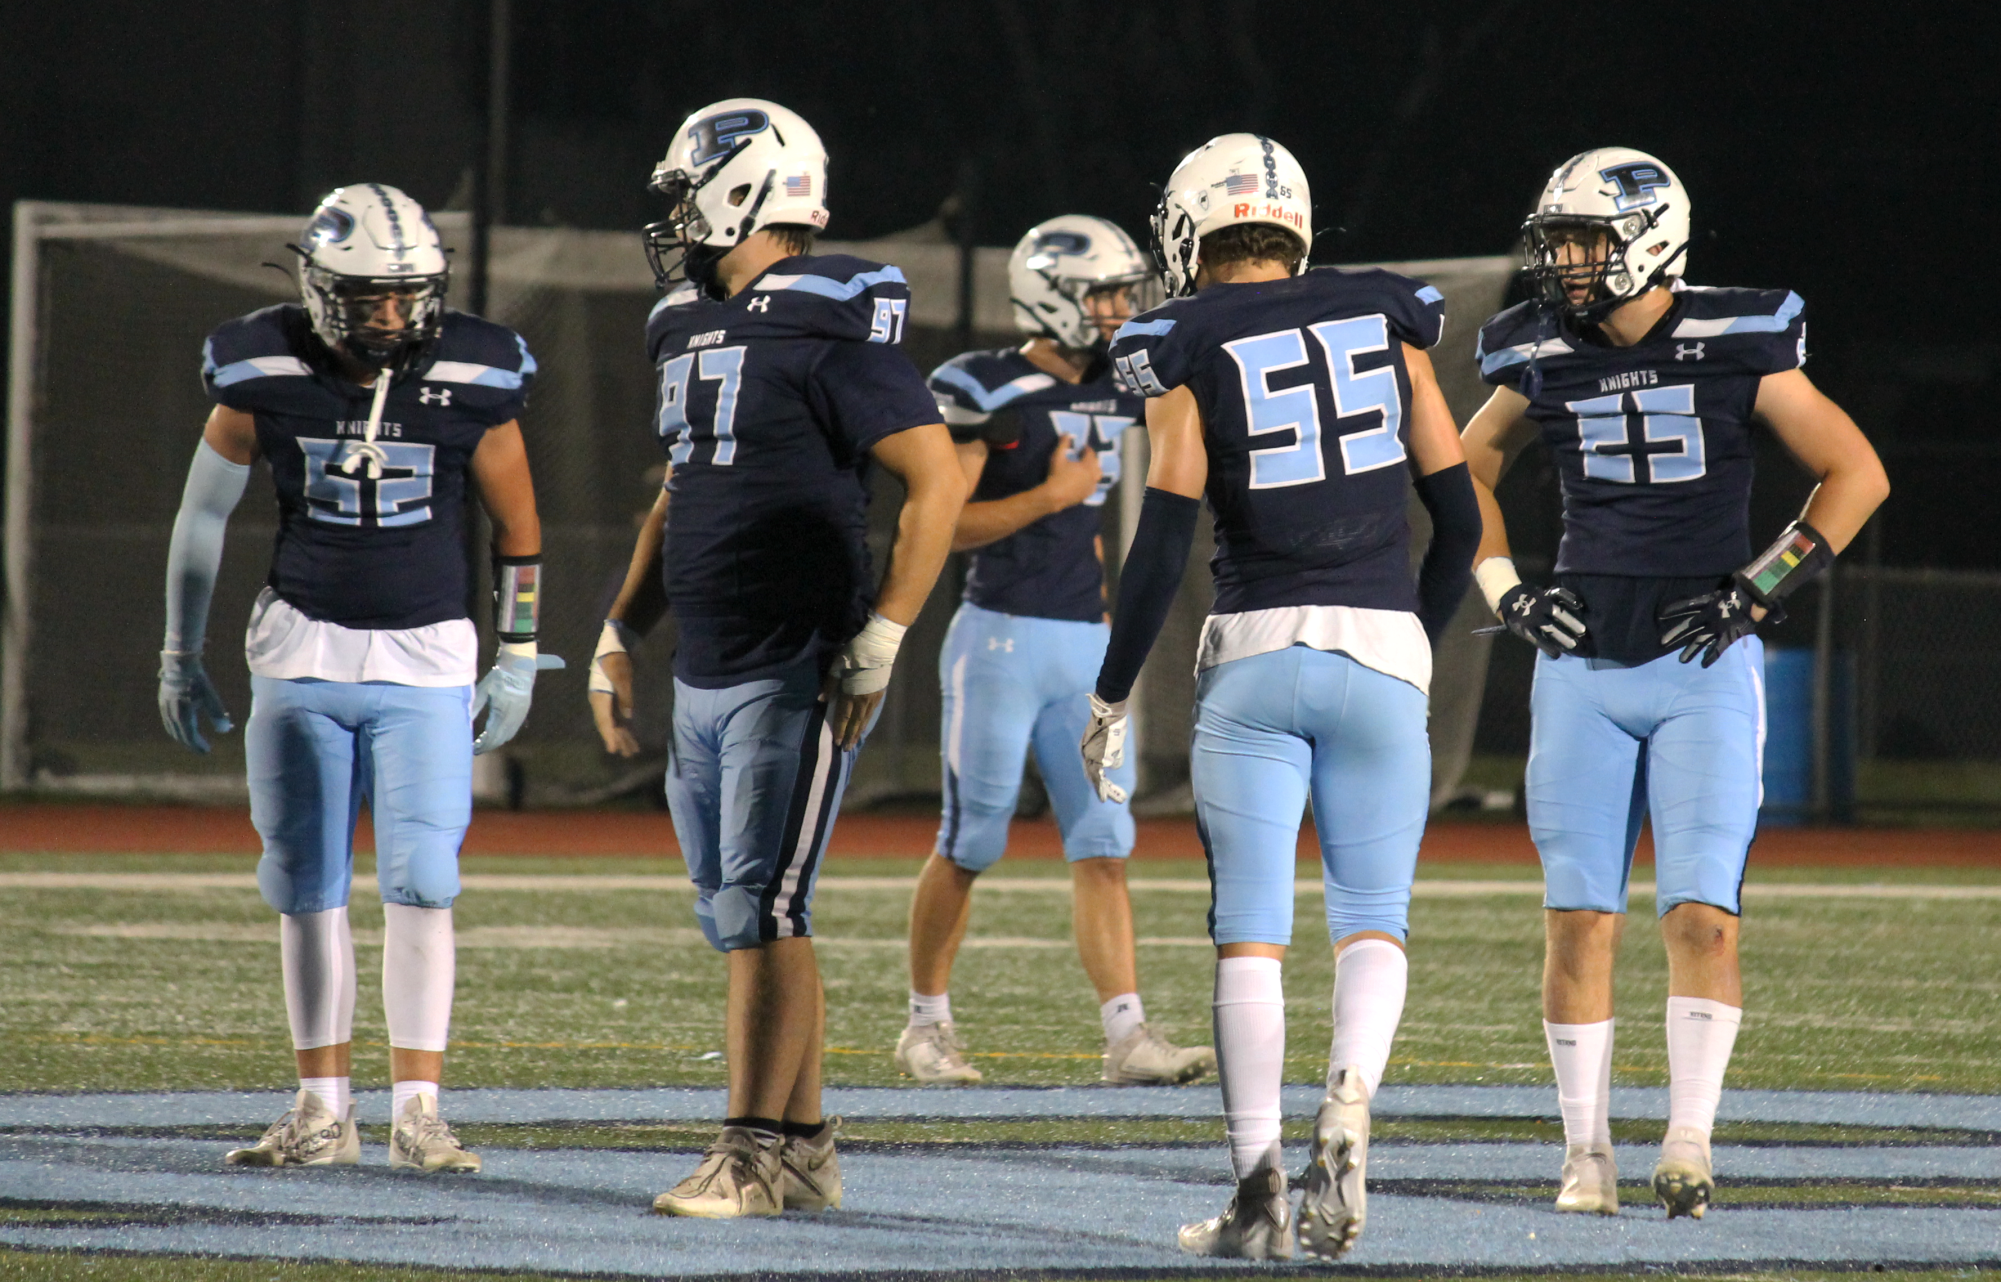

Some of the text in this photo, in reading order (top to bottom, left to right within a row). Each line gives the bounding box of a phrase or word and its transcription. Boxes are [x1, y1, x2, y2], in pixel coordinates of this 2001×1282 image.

[1234, 202, 1304, 230] Riddell
[686, 329, 727, 349] KNIGHTS
[866, 296, 907, 345] 97
[1115, 348, 1171, 397] 55
[1599, 369, 1659, 393] KNIGHTS
[659, 346, 748, 466] 97
[1221, 313, 1407, 490] 55
[1565, 383, 1707, 485] 25
[296, 436, 436, 528] 52
